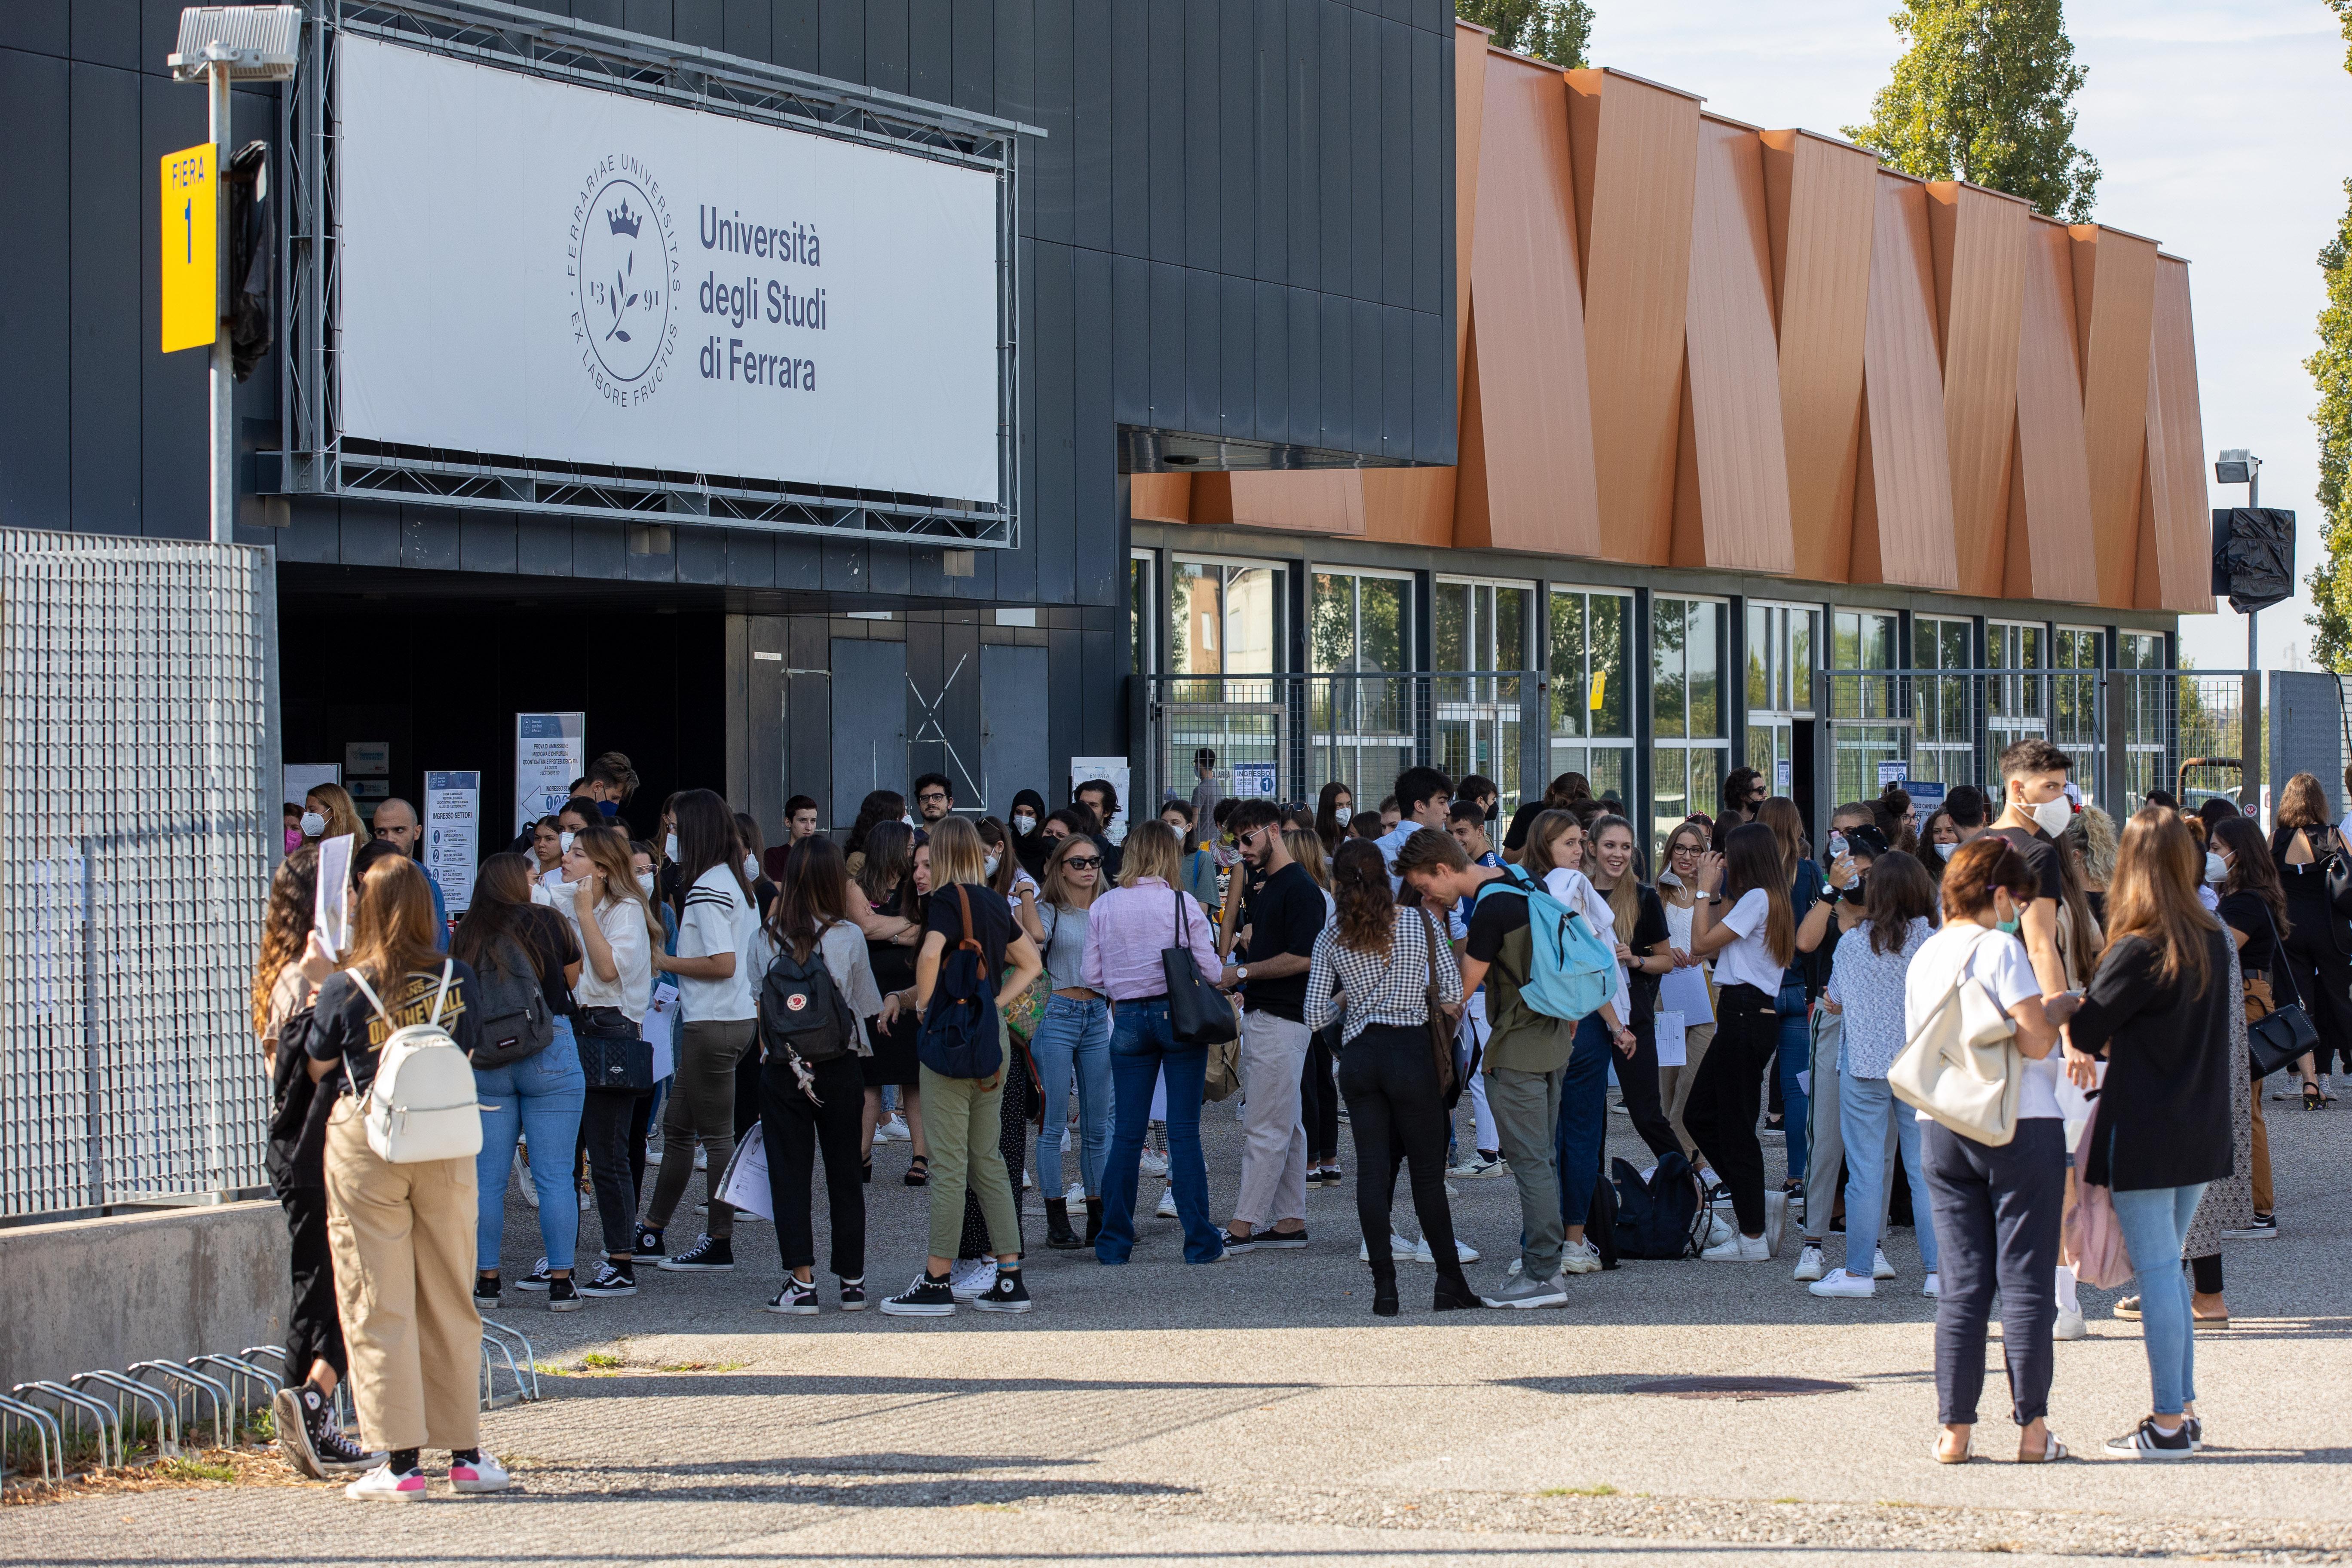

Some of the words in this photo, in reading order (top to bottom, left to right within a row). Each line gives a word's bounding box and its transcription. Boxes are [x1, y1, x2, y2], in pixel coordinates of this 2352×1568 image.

[173, 156, 205, 190] FIERA
[184, 198, 191, 263] 1
[568, 155, 614, 276] FERRARIAE
[622, 153, 680, 292] UNIVERSITAS
[700, 205, 820, 267] Università
[591, 282, 604, 305] 13
[644, 289, 659, 312] 91
[700, 272, 758, 328] degli
[767, 280, 826, 330] Studi
[572, 311, 584, 344] EX
[582, 349, 627, 408] LABORE
[634, 325, 678, 406] FRUCTUS
[700, 336, 720, 380] di
[730, 339, 815, 392] Ferrara
